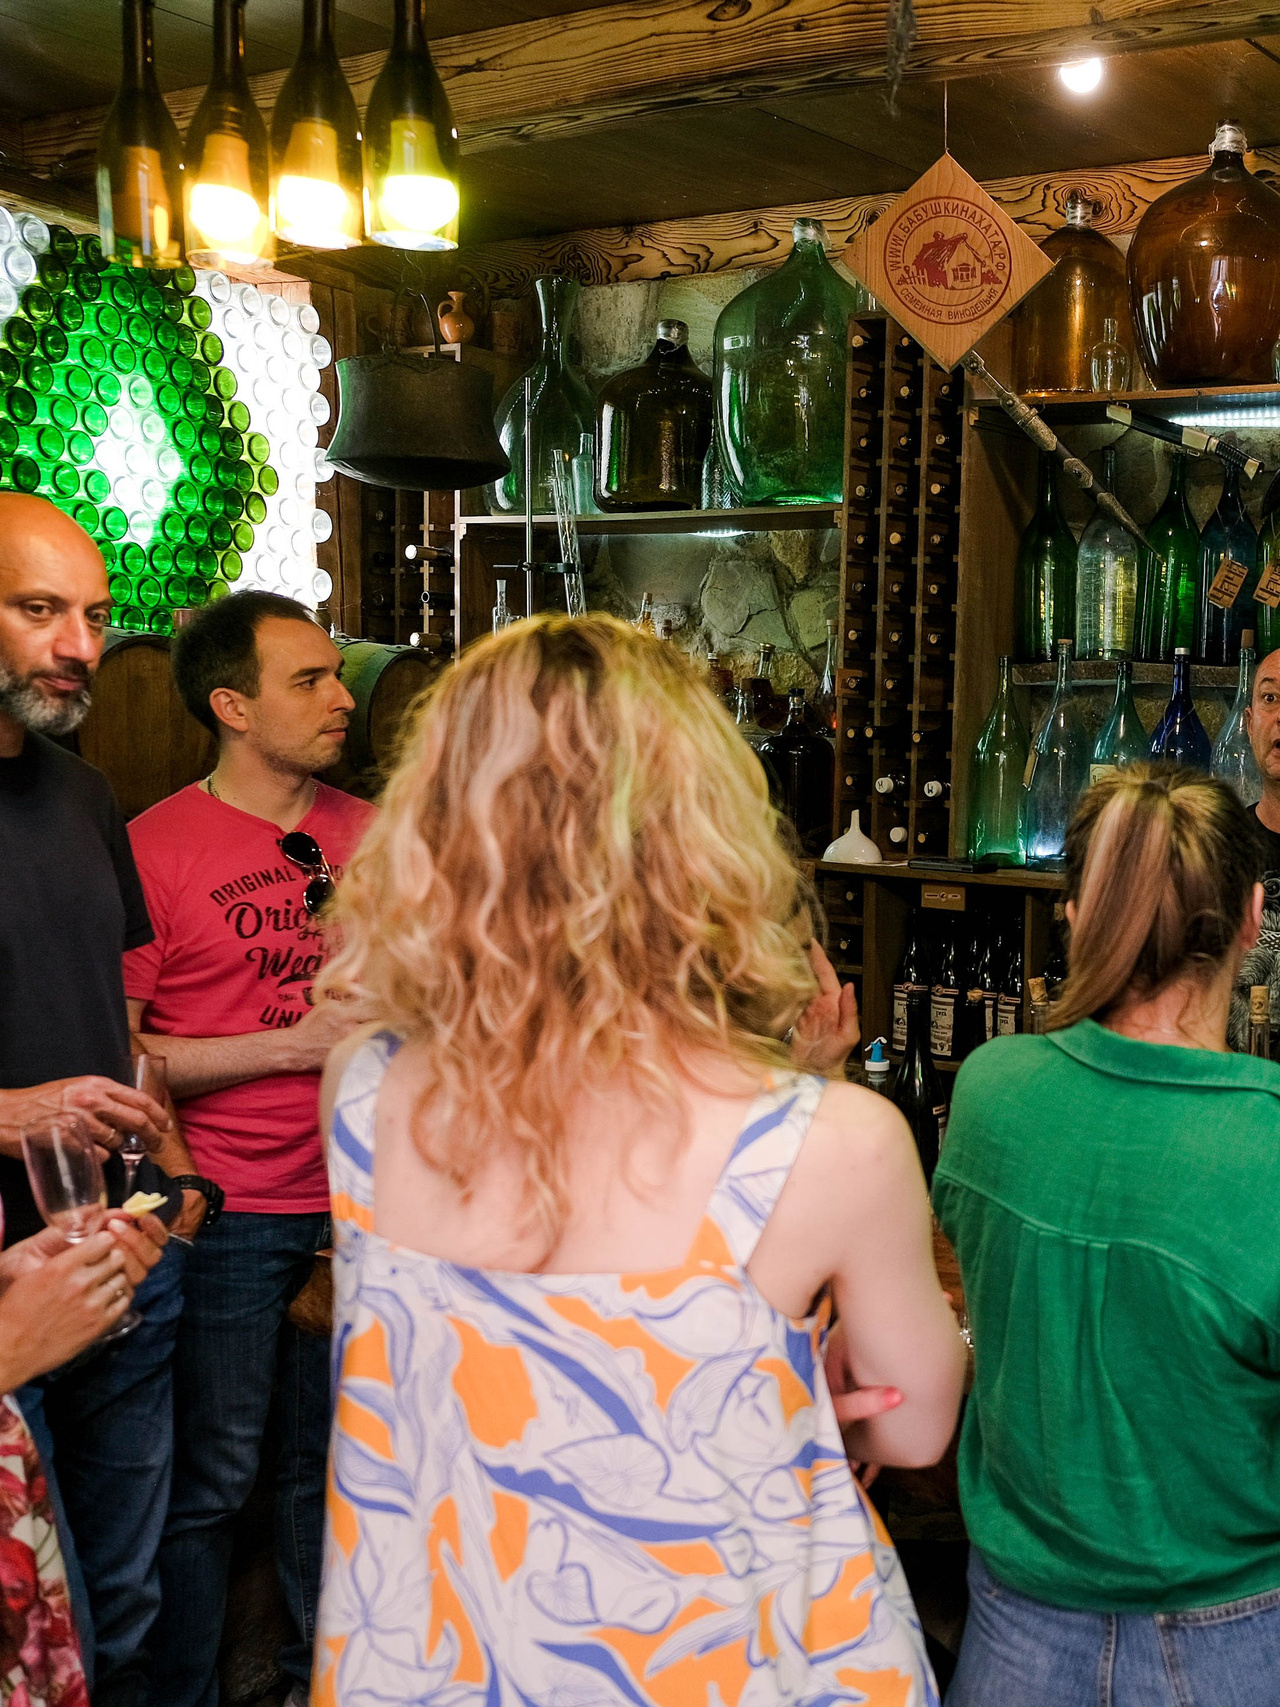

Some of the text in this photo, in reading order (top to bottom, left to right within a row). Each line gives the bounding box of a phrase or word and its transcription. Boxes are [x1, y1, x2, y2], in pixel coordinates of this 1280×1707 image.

[888, 201, 1006, 271] WWW.БАБУШКИНАХАТА.РФ
[947, 288, 999, 320] ВИНОДЕЛЬНЯ
[210, 865, 296, 907] ORIGINAL
[225, 899, 323, 941] Orig
[245, 947, 323, 980] Wea
